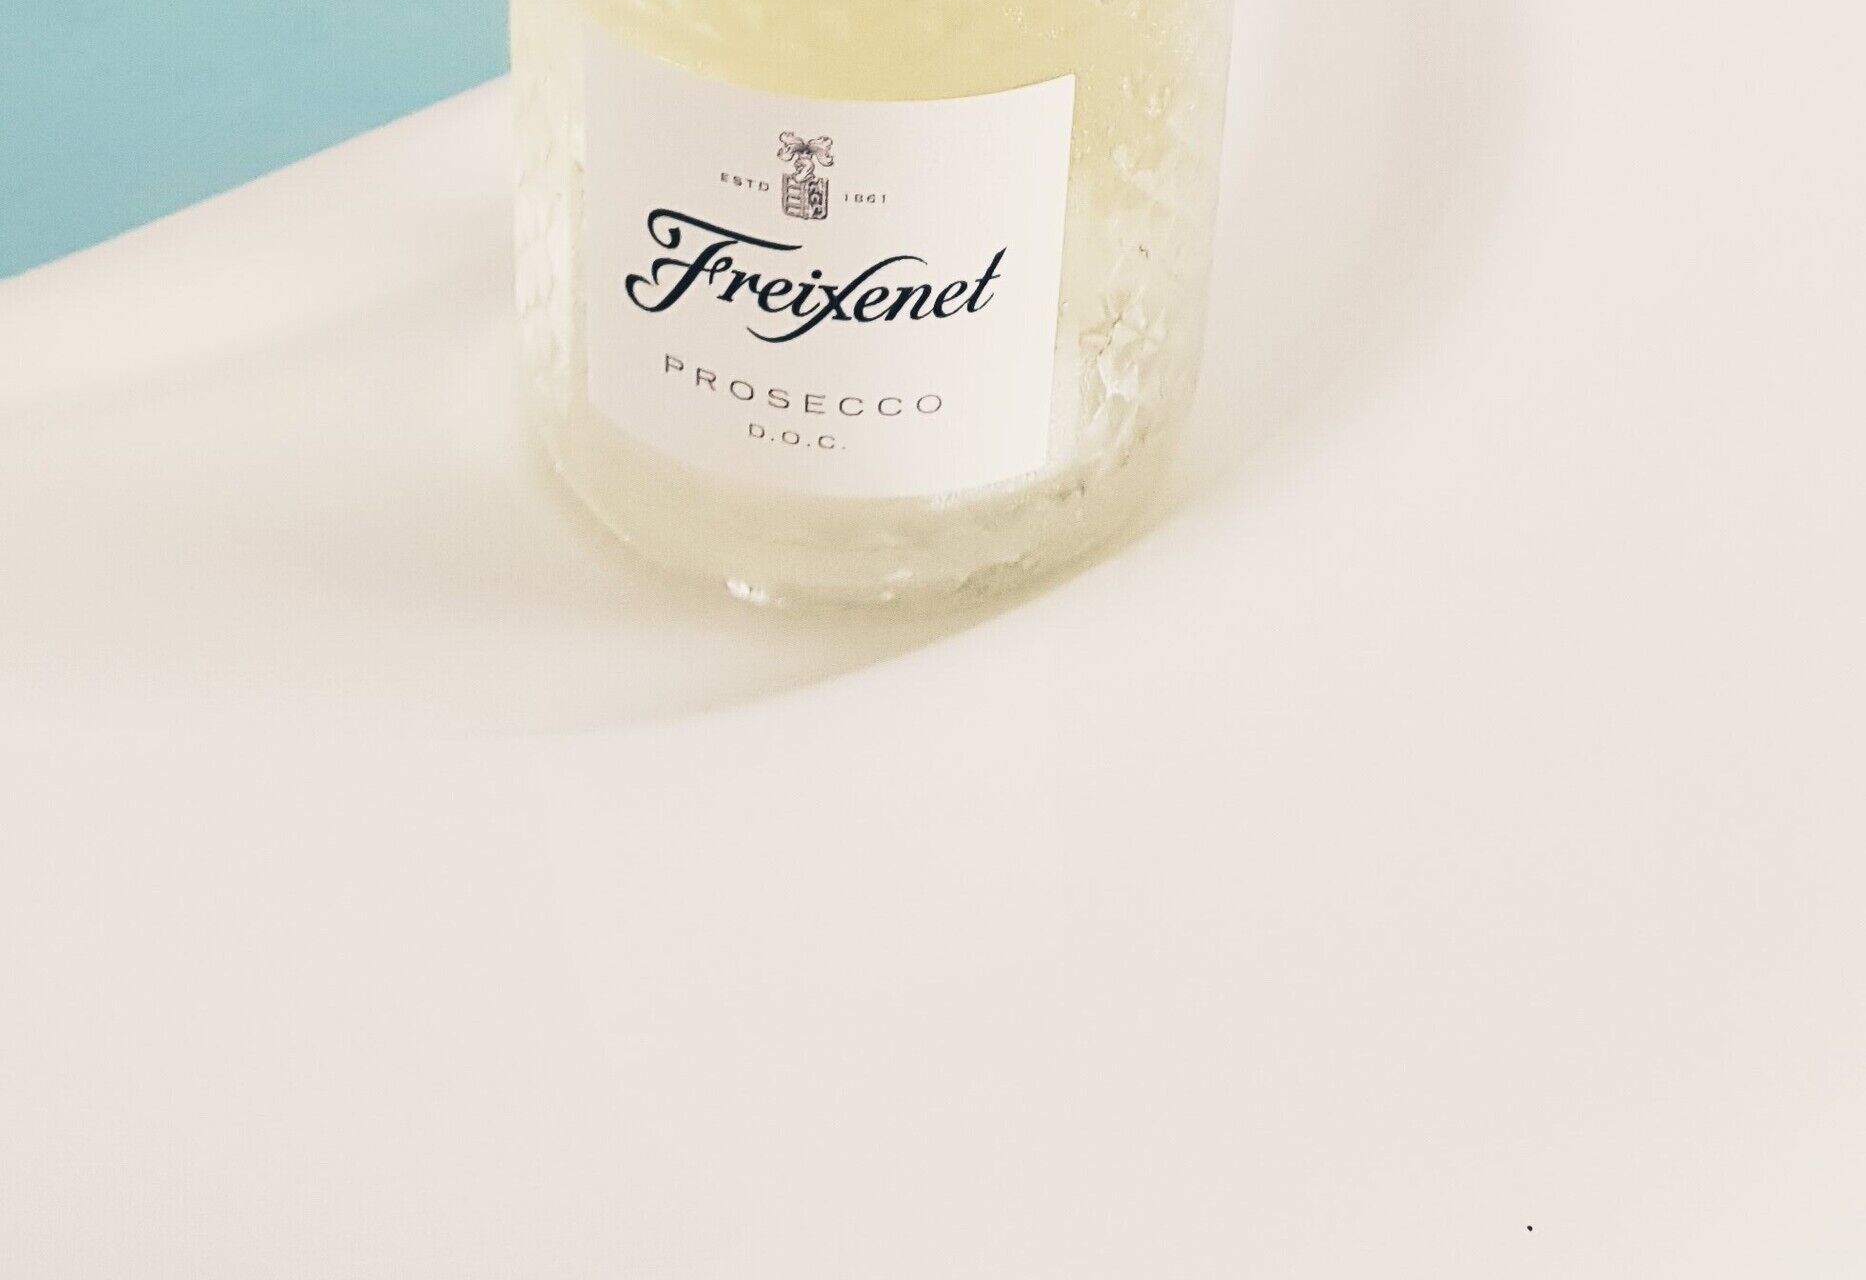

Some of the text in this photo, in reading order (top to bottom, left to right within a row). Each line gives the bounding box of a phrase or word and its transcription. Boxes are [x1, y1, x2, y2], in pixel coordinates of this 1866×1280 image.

[720, 171, 888, 204] ESTD 1861
[624, 208, 1007, 344] Freixenet
[663, 352, 944, 417] PROSECCO
[747, 422, 847, 451] D.O.C.
